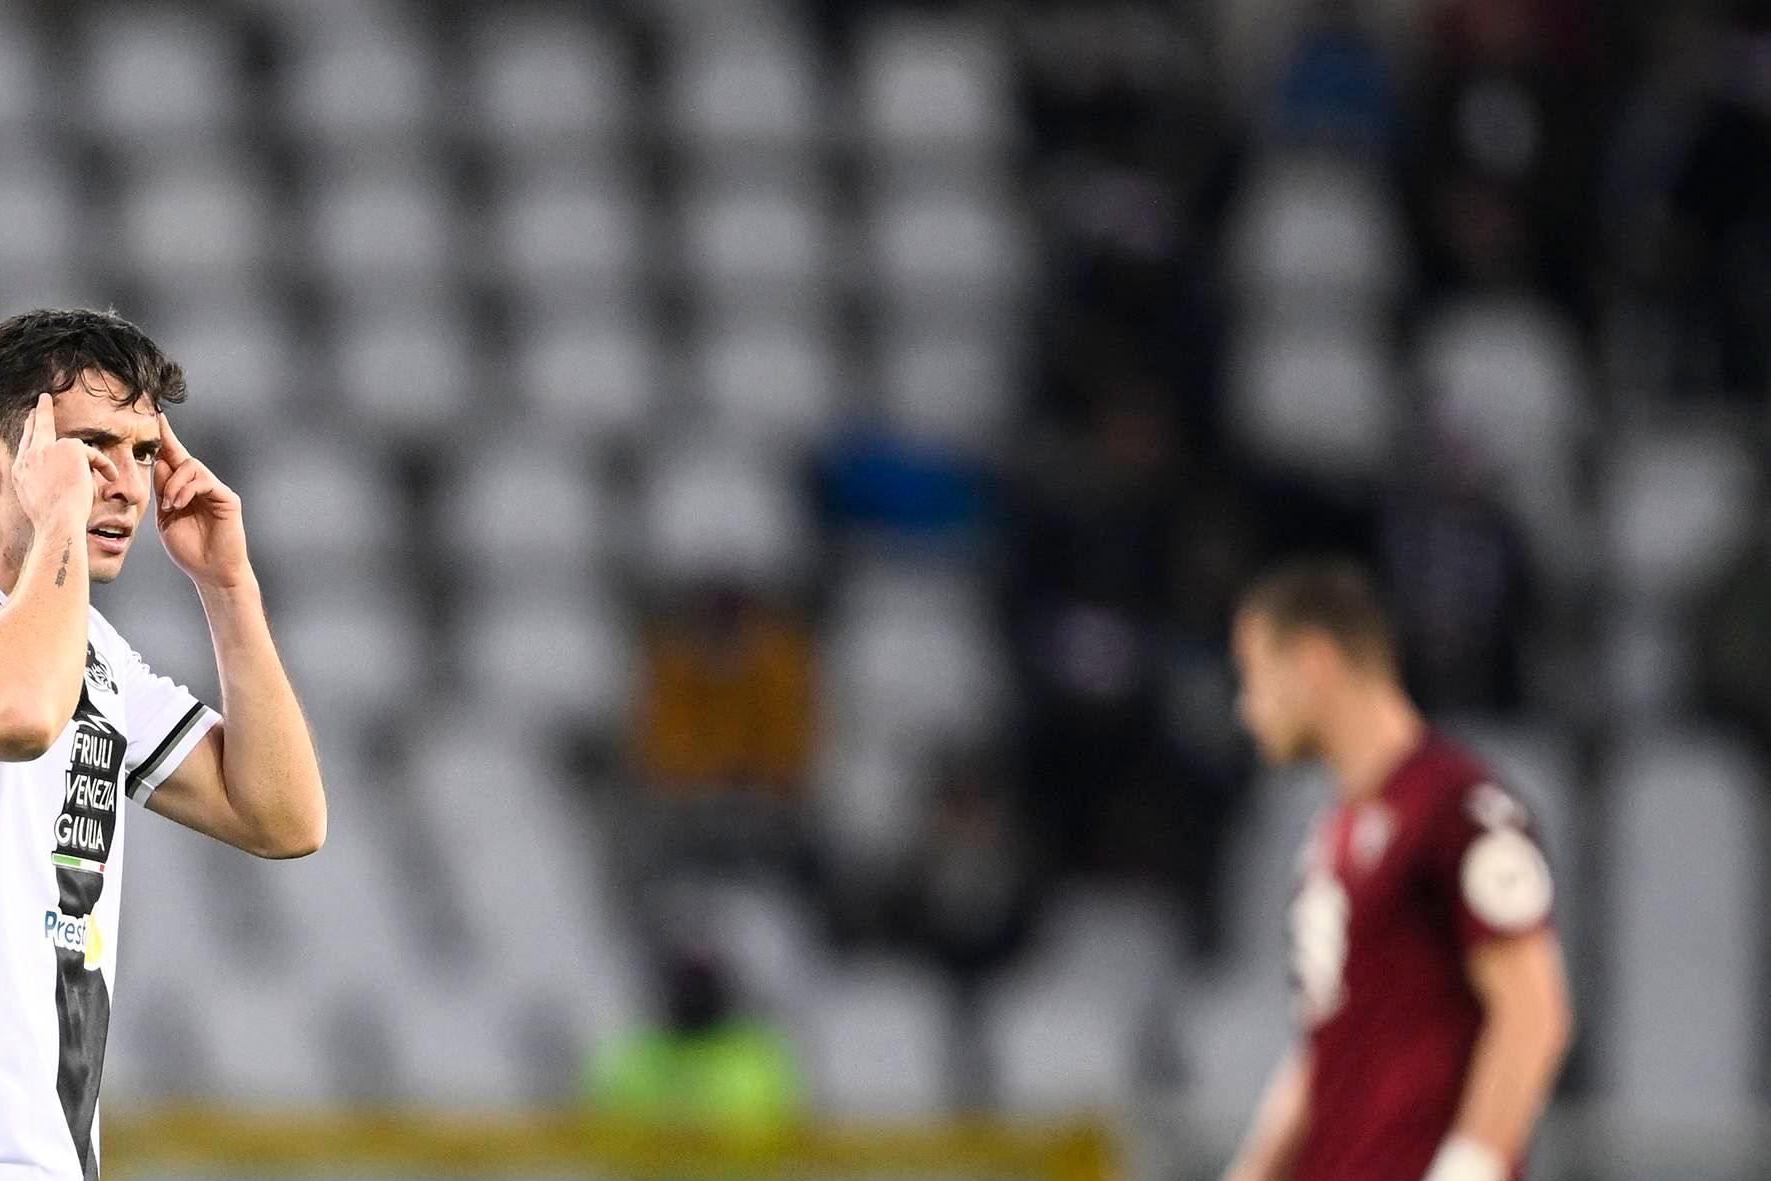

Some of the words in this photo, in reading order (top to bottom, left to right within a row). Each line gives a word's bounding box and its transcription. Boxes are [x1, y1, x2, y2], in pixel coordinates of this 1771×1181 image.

[71, 732, 113, 769] FRIULI
[66, 771, 116, 813] VENEZIA
[54, 813, 105, 852] GIULIA
